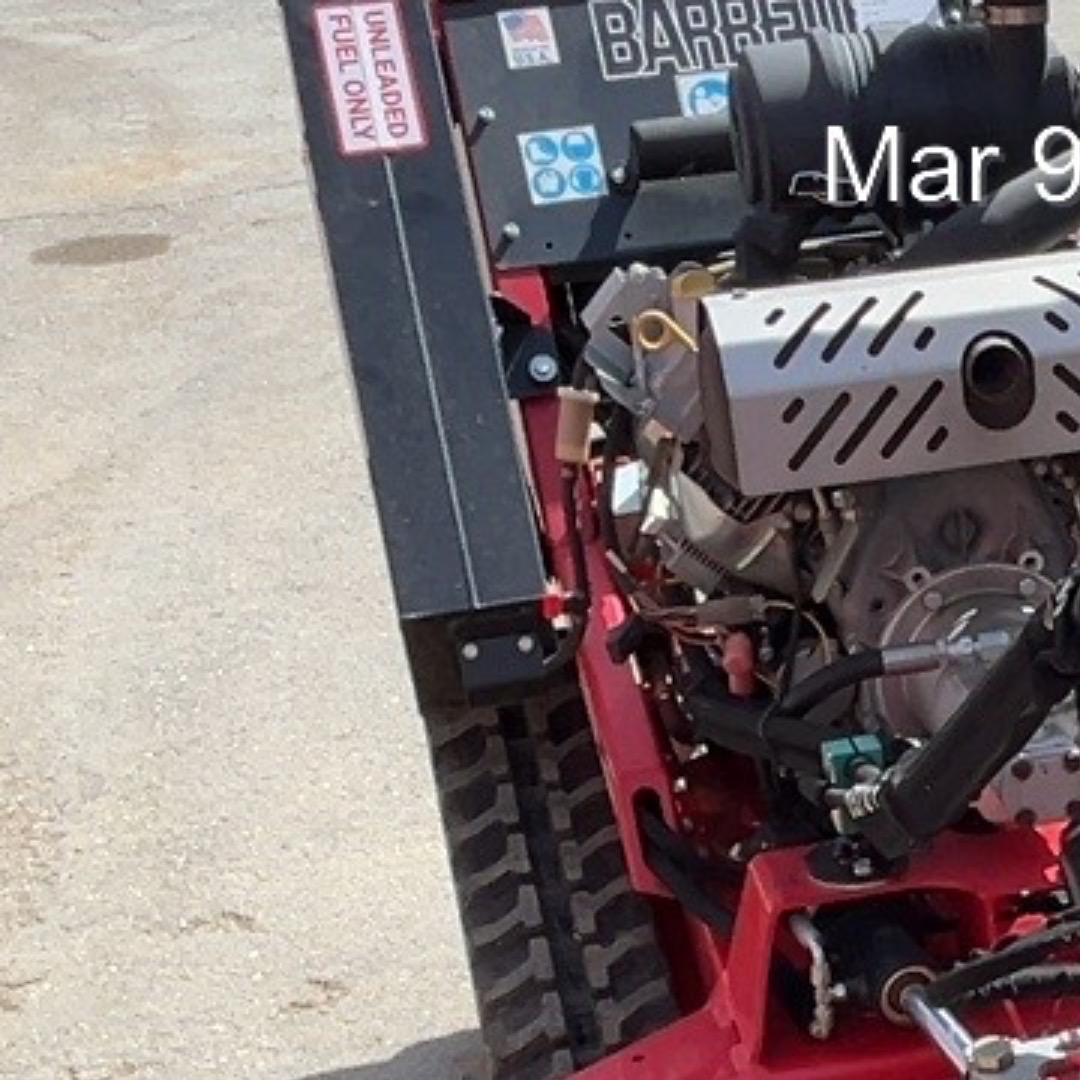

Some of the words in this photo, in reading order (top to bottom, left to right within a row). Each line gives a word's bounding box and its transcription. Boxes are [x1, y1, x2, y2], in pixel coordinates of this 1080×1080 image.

[328, 14, 359, 73] FUEL
[364, 10, 409, 139] UNLEADED
[342, 80, 376, 138] ONLY
